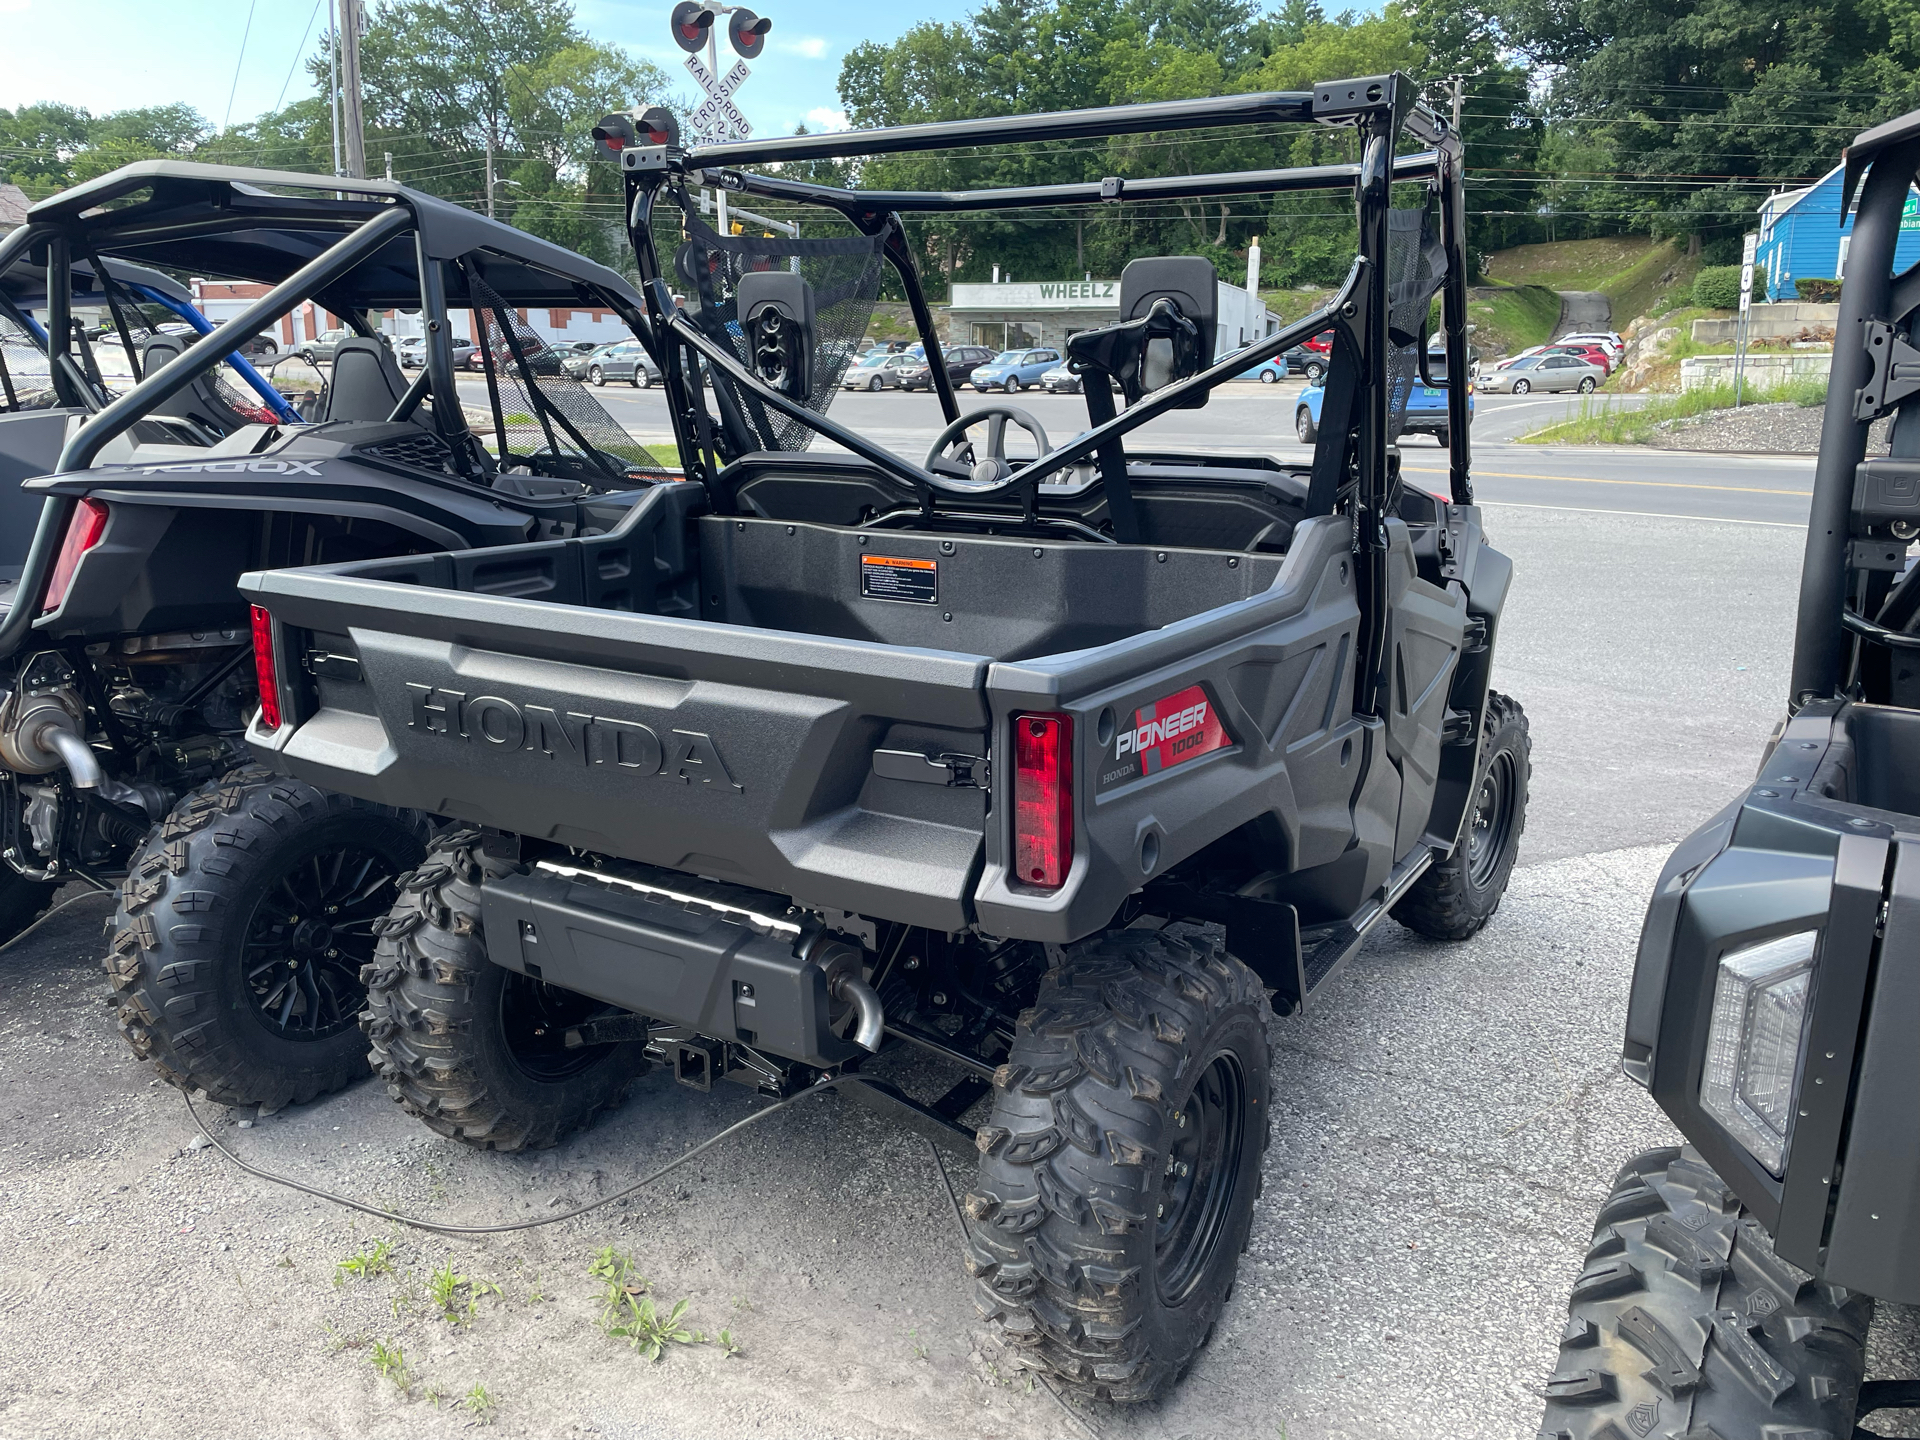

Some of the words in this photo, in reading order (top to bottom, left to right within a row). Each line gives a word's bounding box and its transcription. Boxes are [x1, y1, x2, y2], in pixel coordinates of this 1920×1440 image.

[687, 56, 713, 92] RAIL
[722, 101, 749, 135] ROAD
[693, 64, 747, 129] CROSSING
[717, 121, 725, 134] 2
[1040, 283, 1114, 299] WHEELZ
[405, 682, 744, 794] HONDA
[1115, 701, 1207, 761] PIONEER
[1172, 731, 1204, 756] 1000
[1102, 763, 1135, 784] HONDA
